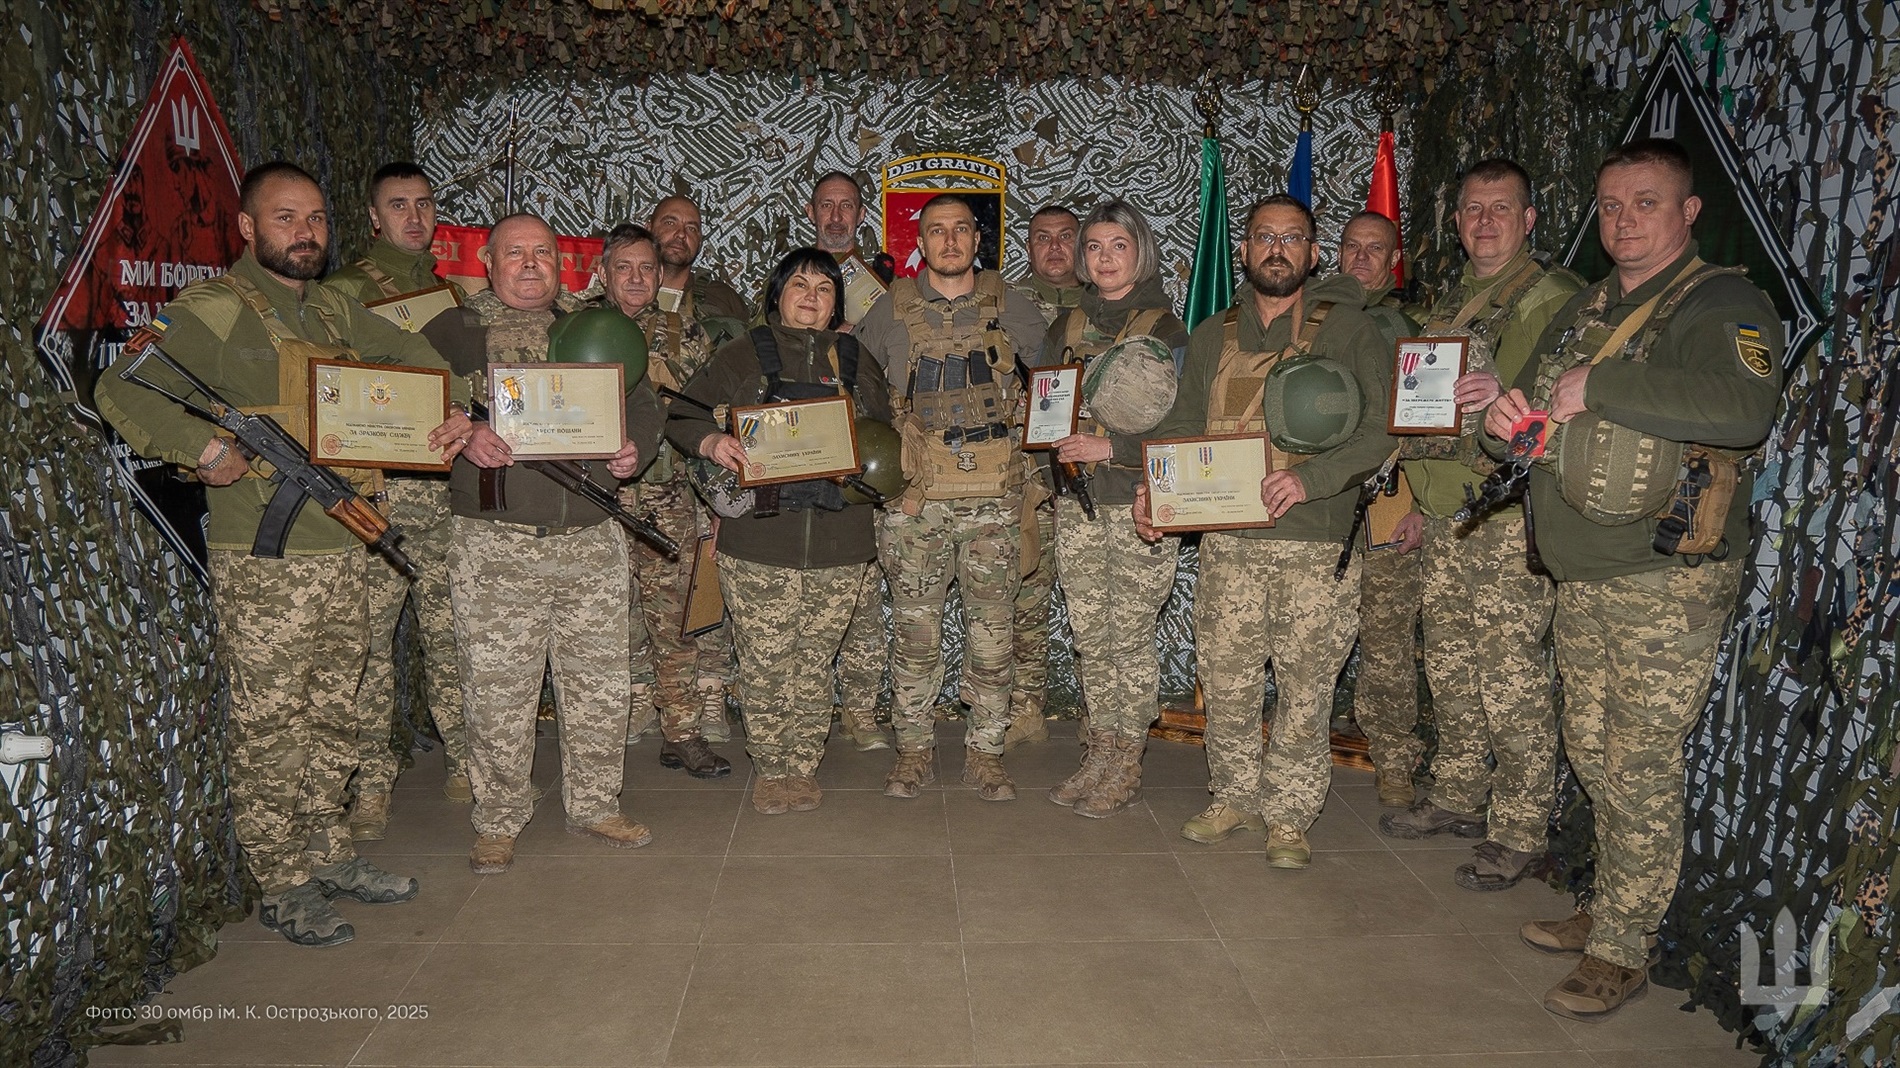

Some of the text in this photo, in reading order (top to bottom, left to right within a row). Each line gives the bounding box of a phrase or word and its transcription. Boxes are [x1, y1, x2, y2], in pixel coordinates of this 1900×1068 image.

[888, 158, 1000, 180] DEI GRATIA
[119, 259, 156, 287] МИ
[124, 301, 152, 327] ЗА
